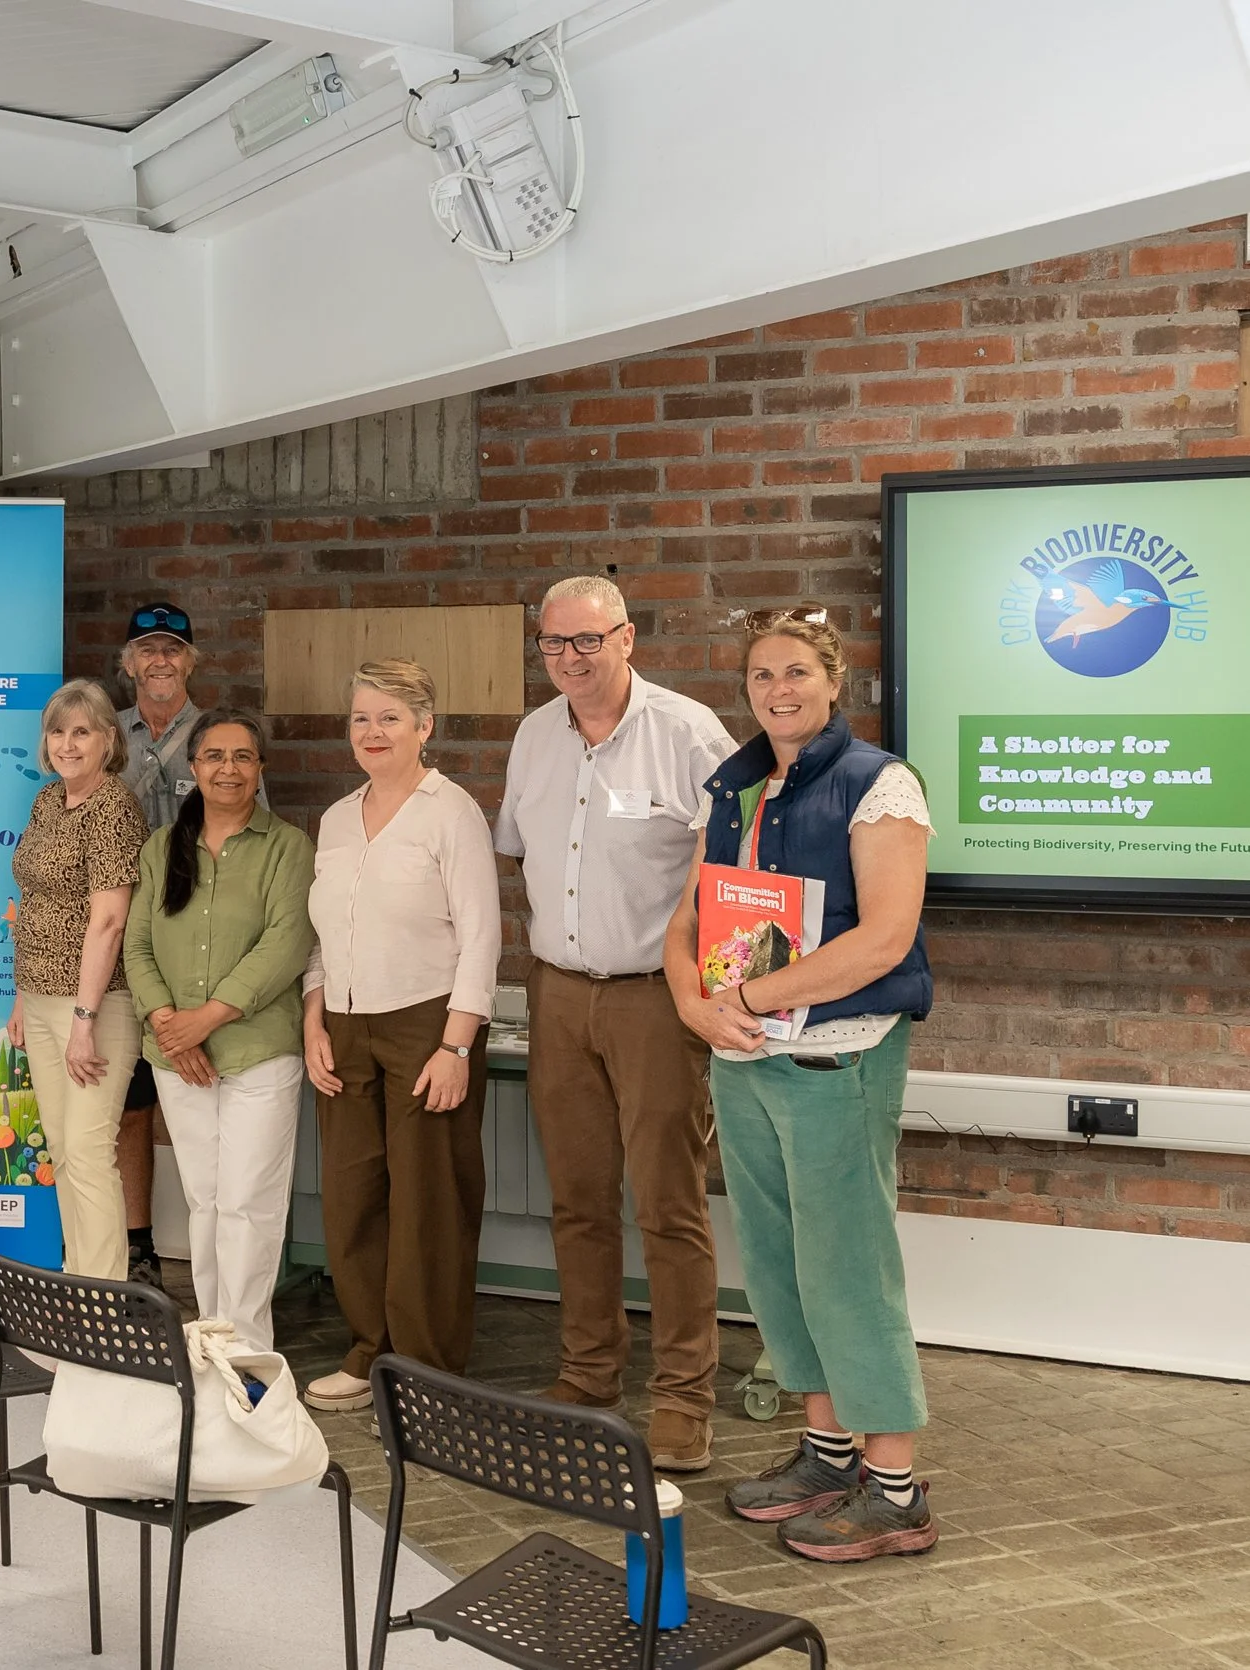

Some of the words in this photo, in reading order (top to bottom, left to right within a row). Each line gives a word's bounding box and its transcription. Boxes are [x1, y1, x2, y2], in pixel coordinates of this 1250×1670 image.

[998, 579, 1035, 645] CORK
[1020, 523, 1199, 586] BIODIVERSITY
[1174, 590, 1208, 642] HUB
[979, 736, 998, 753] A
[1004, 736, 1115, 754] Shelter
[1122, 736, 1170, 754] for
[979, 766, 1146, 788] Knowledge
[1153, 767, 1212, 784] and
[979, 795, 1153, 819] Community
[964, 838, 1030, 851] Protecting
[1033, 839, 1115, 852] Biodiversity,
[1118, 841, 1191, 854] Preserving
[1195, 842, 1217, 852] the
[1221, 842, 1250, 853] Futu
[723, 882, 779, 898] Communities
[723, 890, 736, 902] in
[738, 892, 780, 909] Bloom
[2, 956, 14, 964] 83
